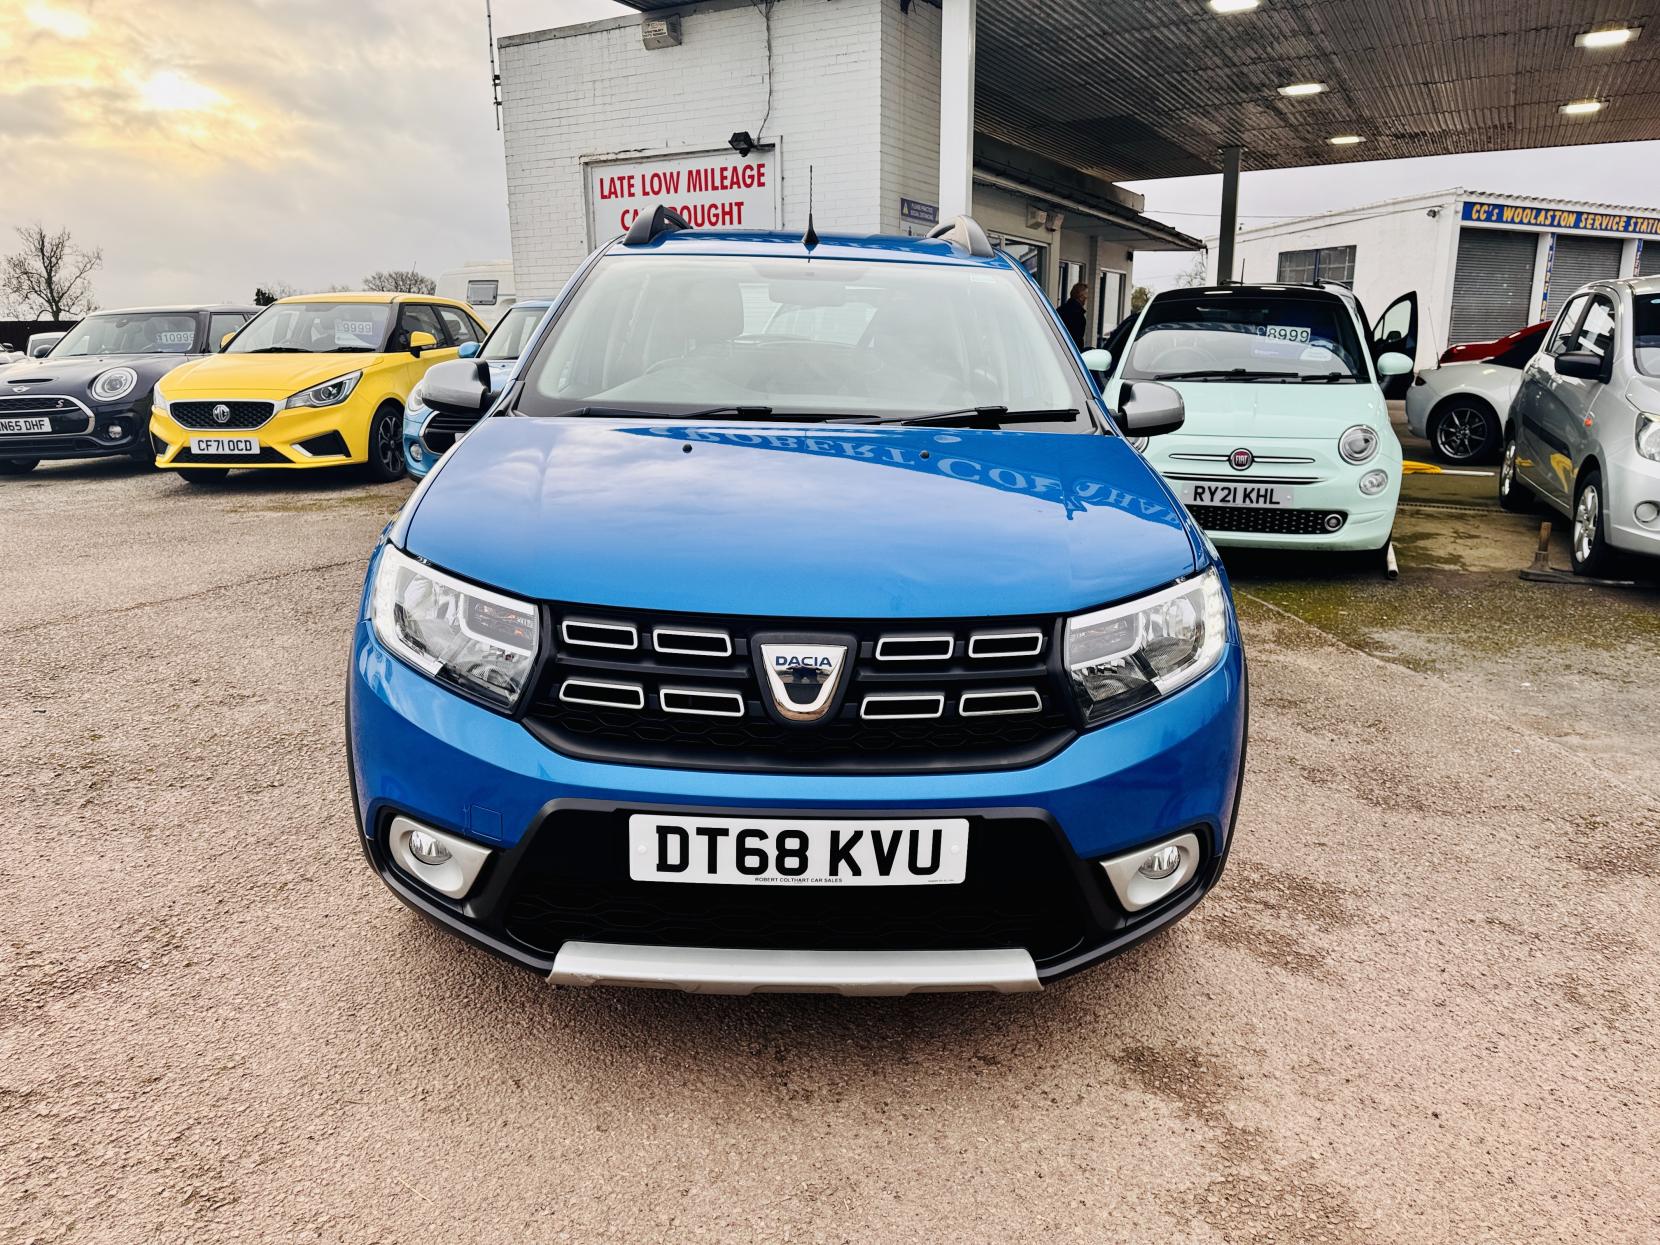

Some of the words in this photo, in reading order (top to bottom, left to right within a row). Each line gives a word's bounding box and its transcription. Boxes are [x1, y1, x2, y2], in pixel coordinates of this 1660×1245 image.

[599, 175, 635, 200] LATE
[641, 170, 680, 197] LOW
[687, 163, 766, 193] MILEAGE
[1503, 206, 1577, 227] WOOLASTON
[1579, 213, 1627, 232] SERVICE
[0, 420, 22, 432] N65
[24, 420, 45, 431] DHF
[197, 440, 225, 452] CF71
[227, 440, 252, 452] OCD
[1235, 455, 1249, 466] FIAT
[1193, 485, 1238, 503] RY21
[1242, 487, 1281, 505] KHL
[775, 655, 833, 667] DACIA
[655, 825, 810, 876] DT68
[828, 829, 943, 876] KVU
